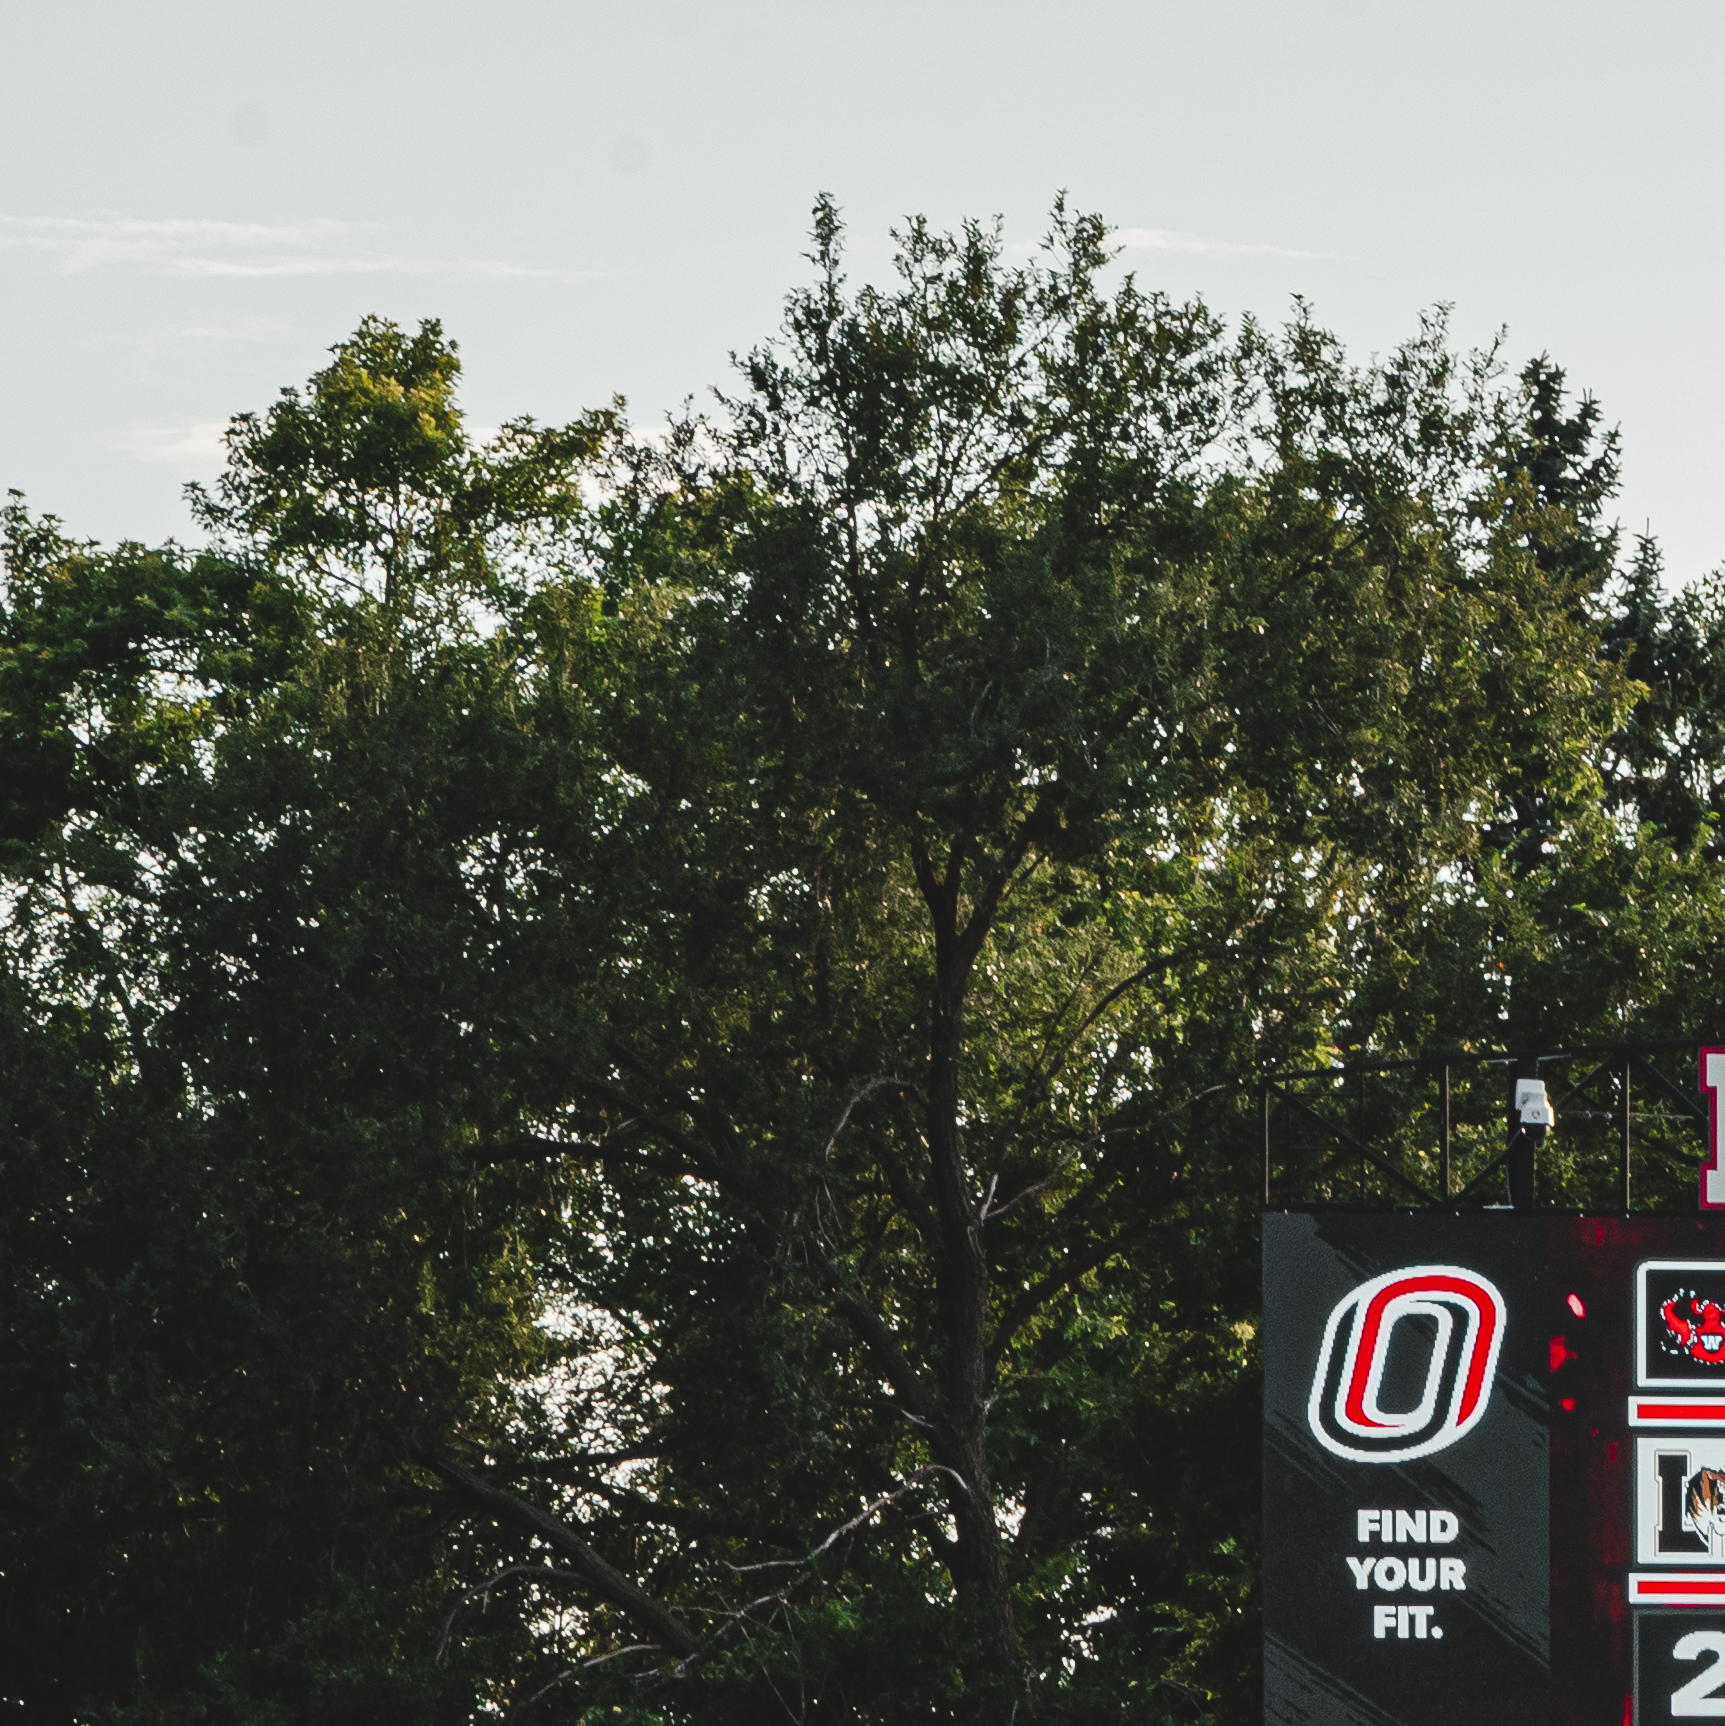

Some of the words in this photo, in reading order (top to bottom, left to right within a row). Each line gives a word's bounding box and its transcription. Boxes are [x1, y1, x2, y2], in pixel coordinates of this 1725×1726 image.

[1356, 1508, 1460, 1544] FIND
[1345, 1556, 1467, 1593] YOUR
[1373, 1604, 1444, 1639] FIT.
